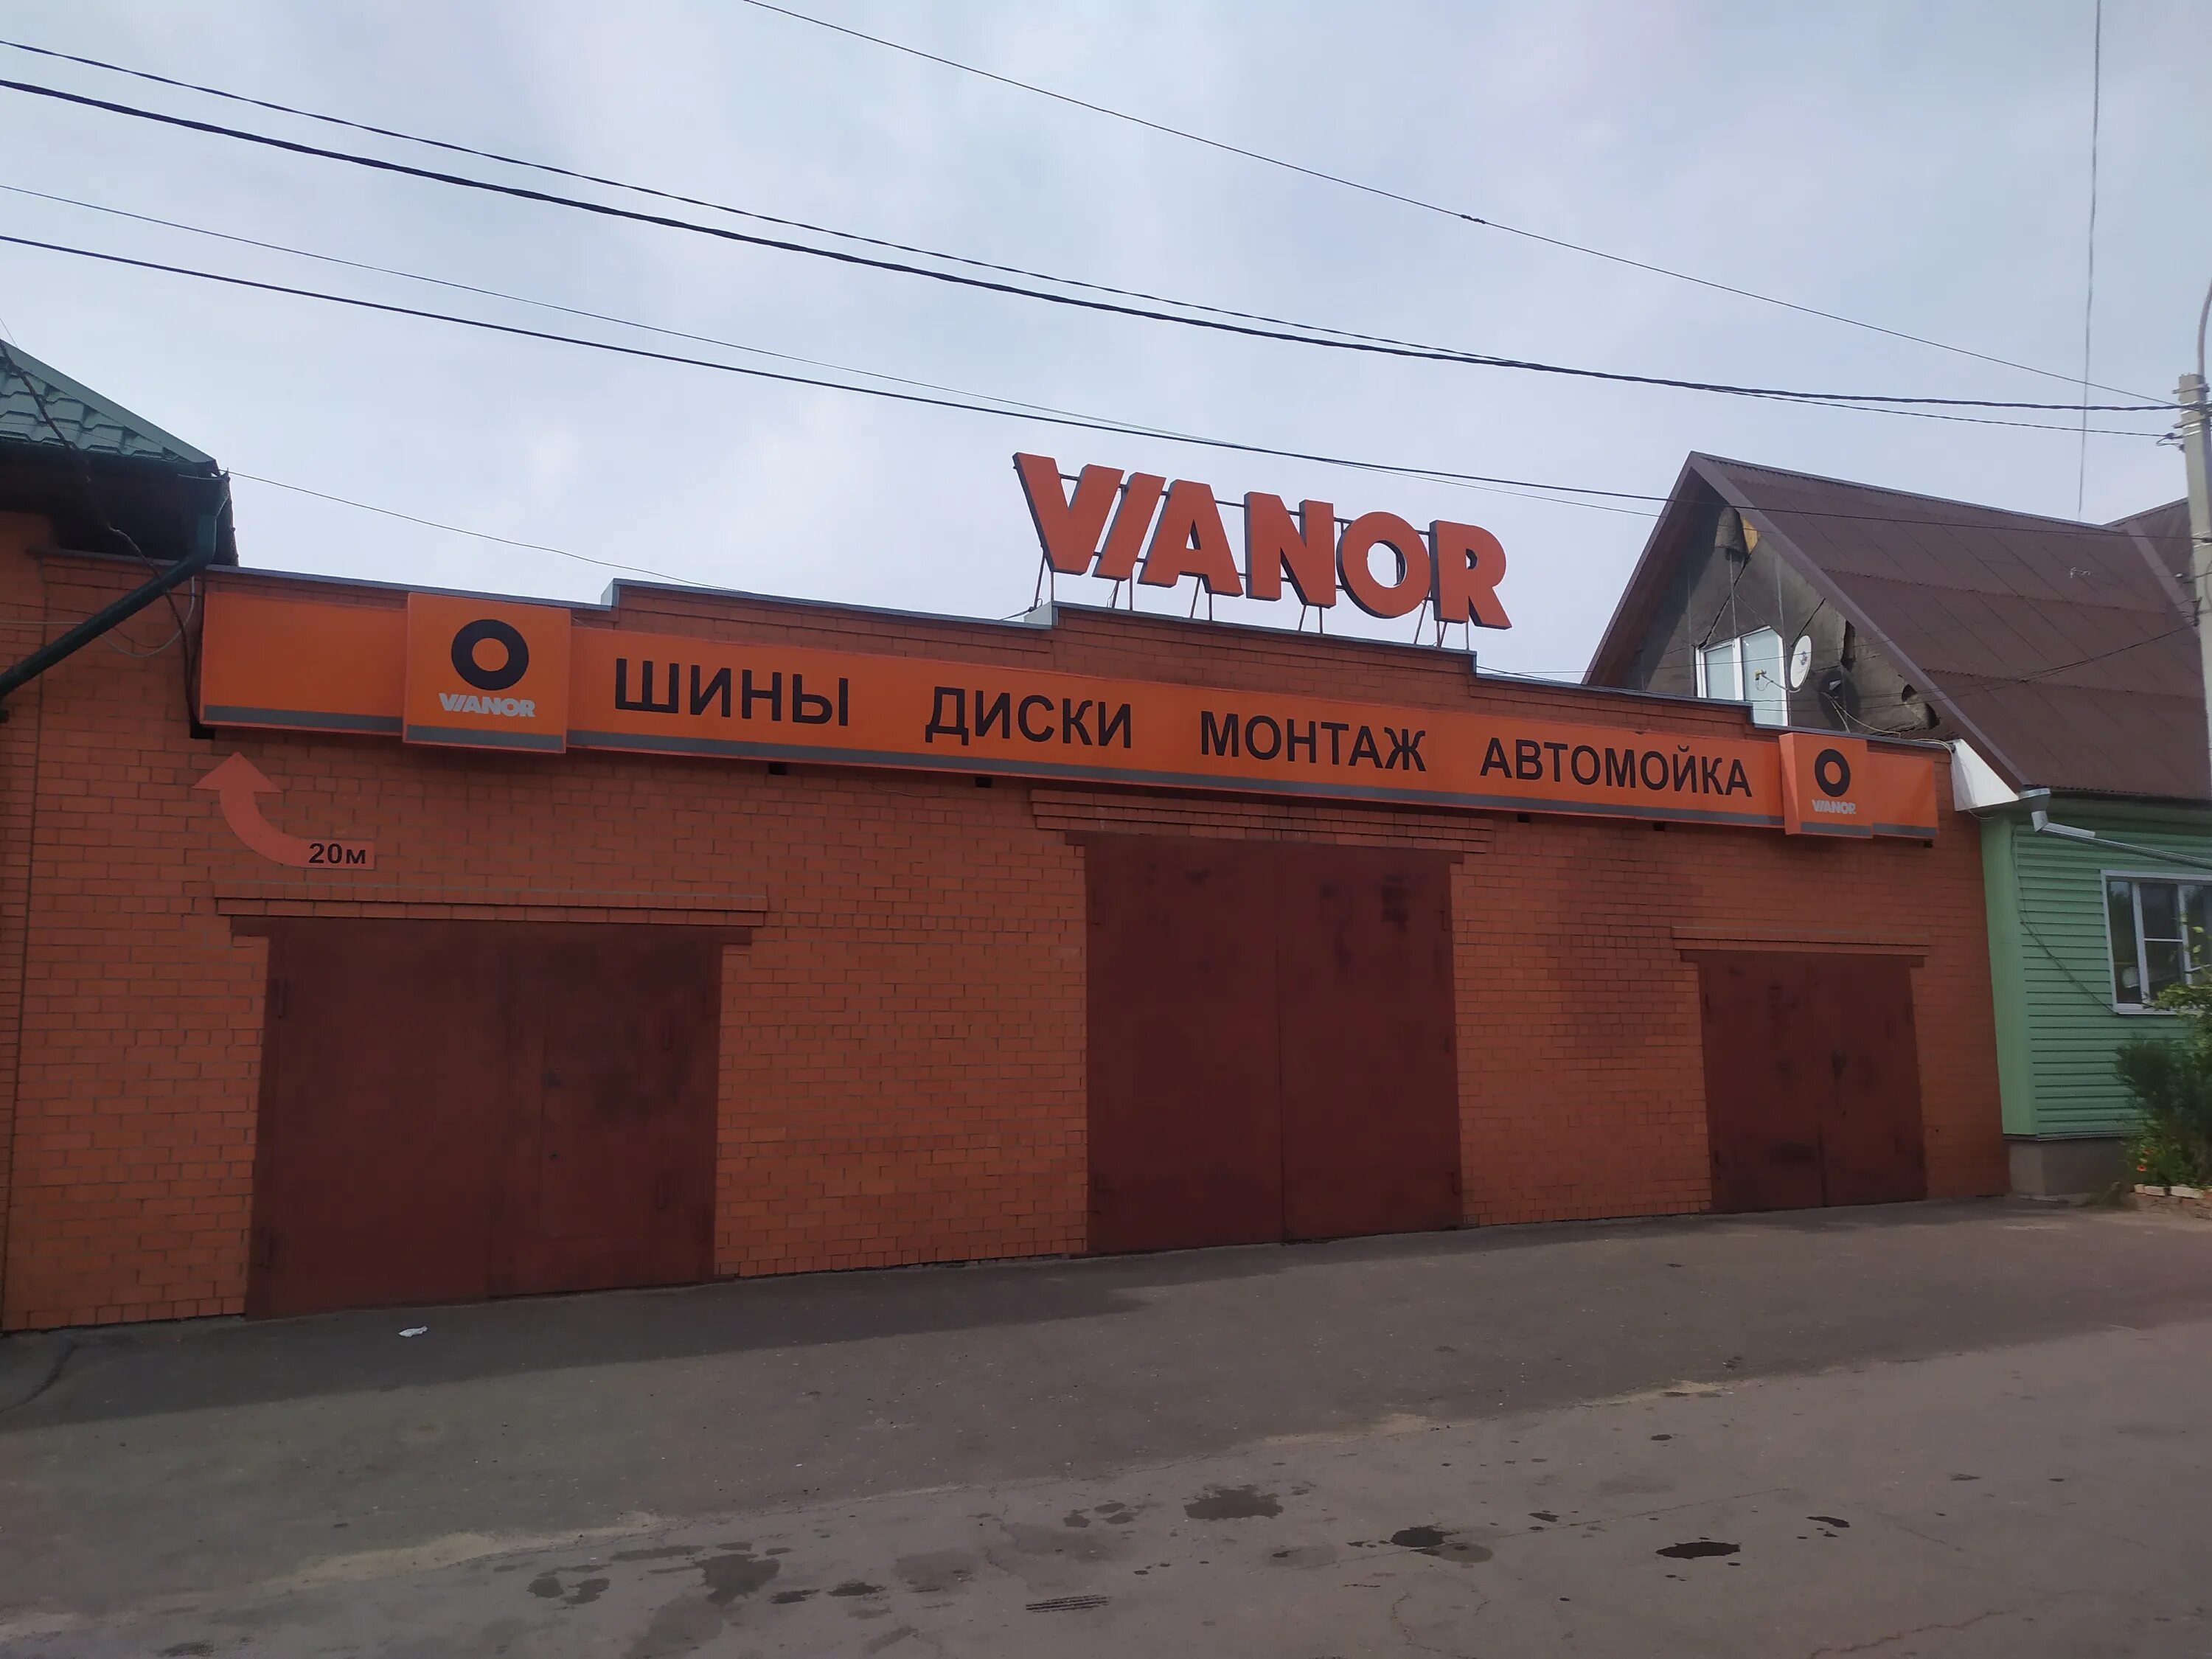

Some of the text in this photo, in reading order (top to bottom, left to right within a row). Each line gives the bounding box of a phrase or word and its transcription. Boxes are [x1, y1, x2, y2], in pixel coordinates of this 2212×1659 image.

[1012, 452, 1512, 630] VIANOR
[438, 693, 535, 717] VIANOR
[615, 658, 1753, 798] ШИНЫ ДИСКИ МОНТАЖ АВТОМОЙКА
[1812, 799, 1856, 815] VIANOR
